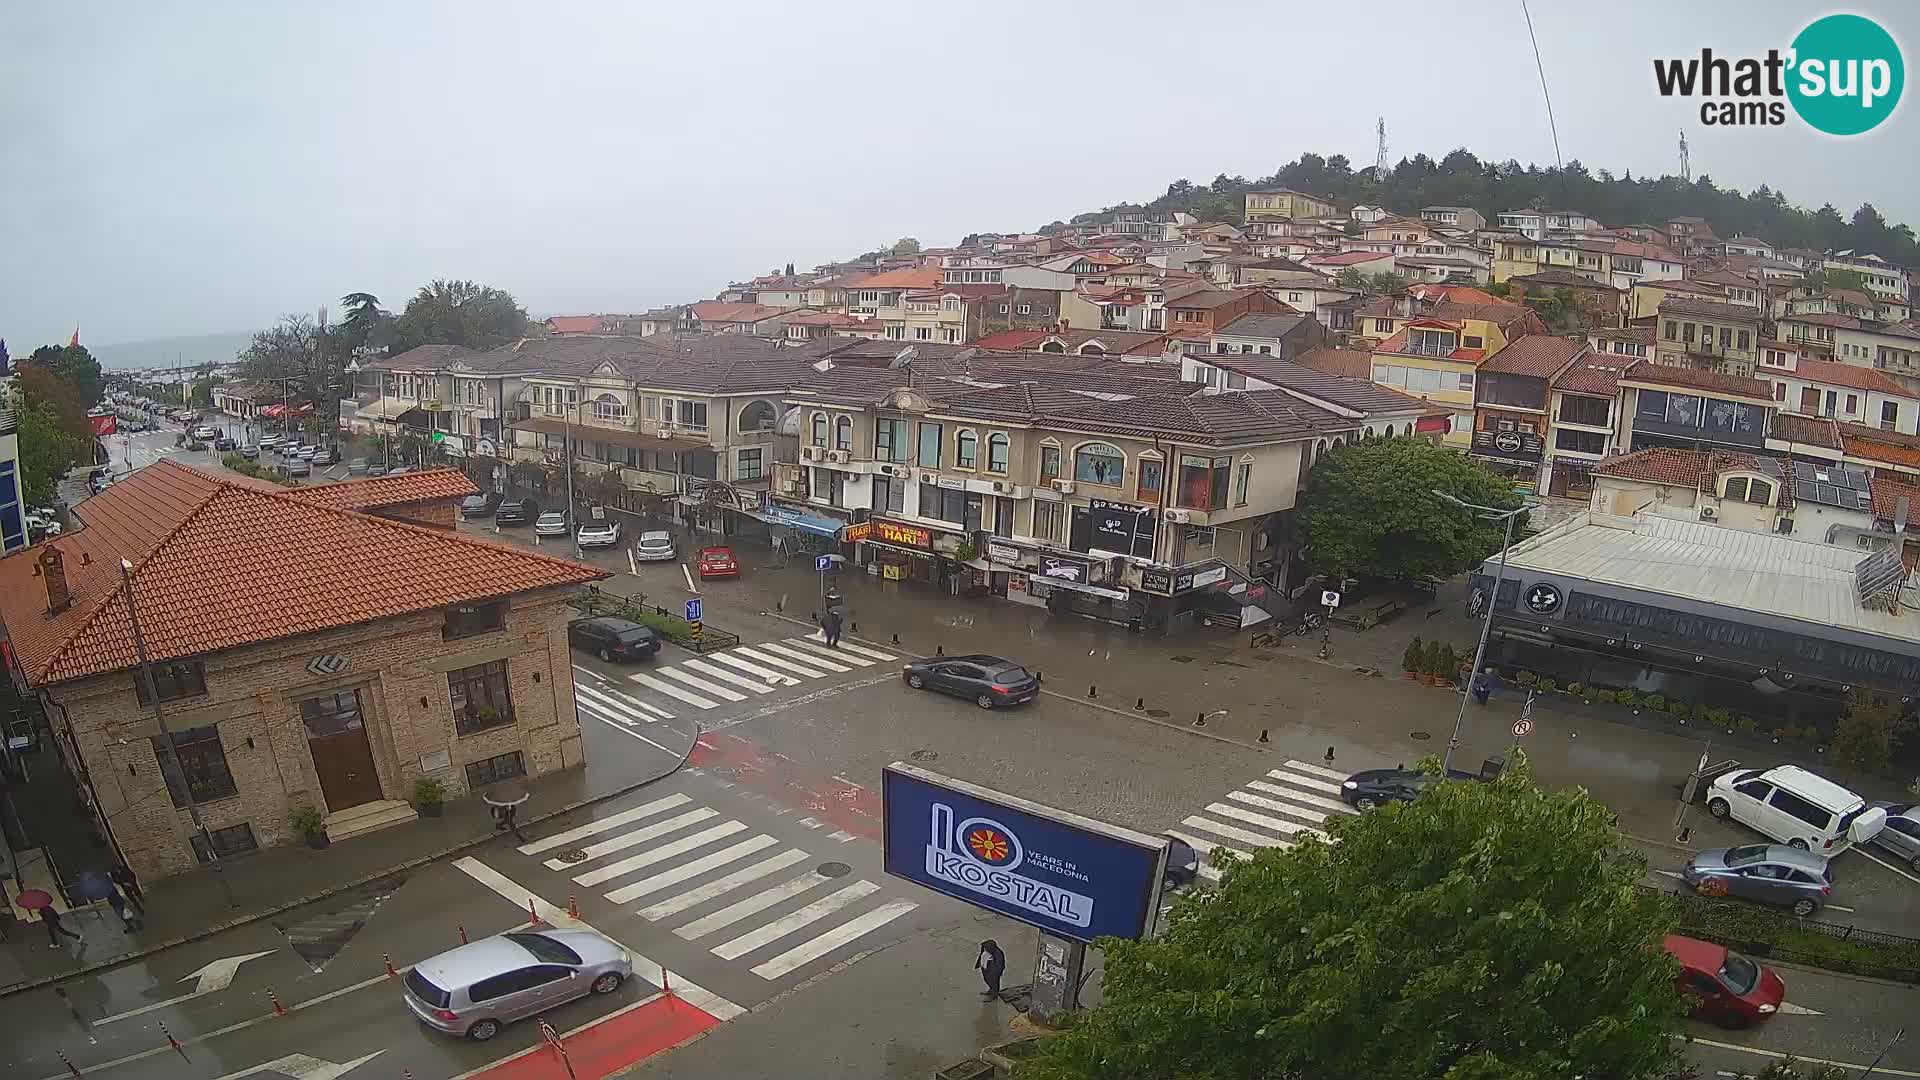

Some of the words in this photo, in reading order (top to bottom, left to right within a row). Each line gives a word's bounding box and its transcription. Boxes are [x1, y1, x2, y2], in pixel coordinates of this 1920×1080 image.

[884, 529, 917, 545] HARI
[1026, 857, 1090, 882] MACEDONIA
[1027, 850, 1063, 866] YEARS
[1065, 860, 1078, 871] IN
[936, 851, 1081, 921] KOSTAL
